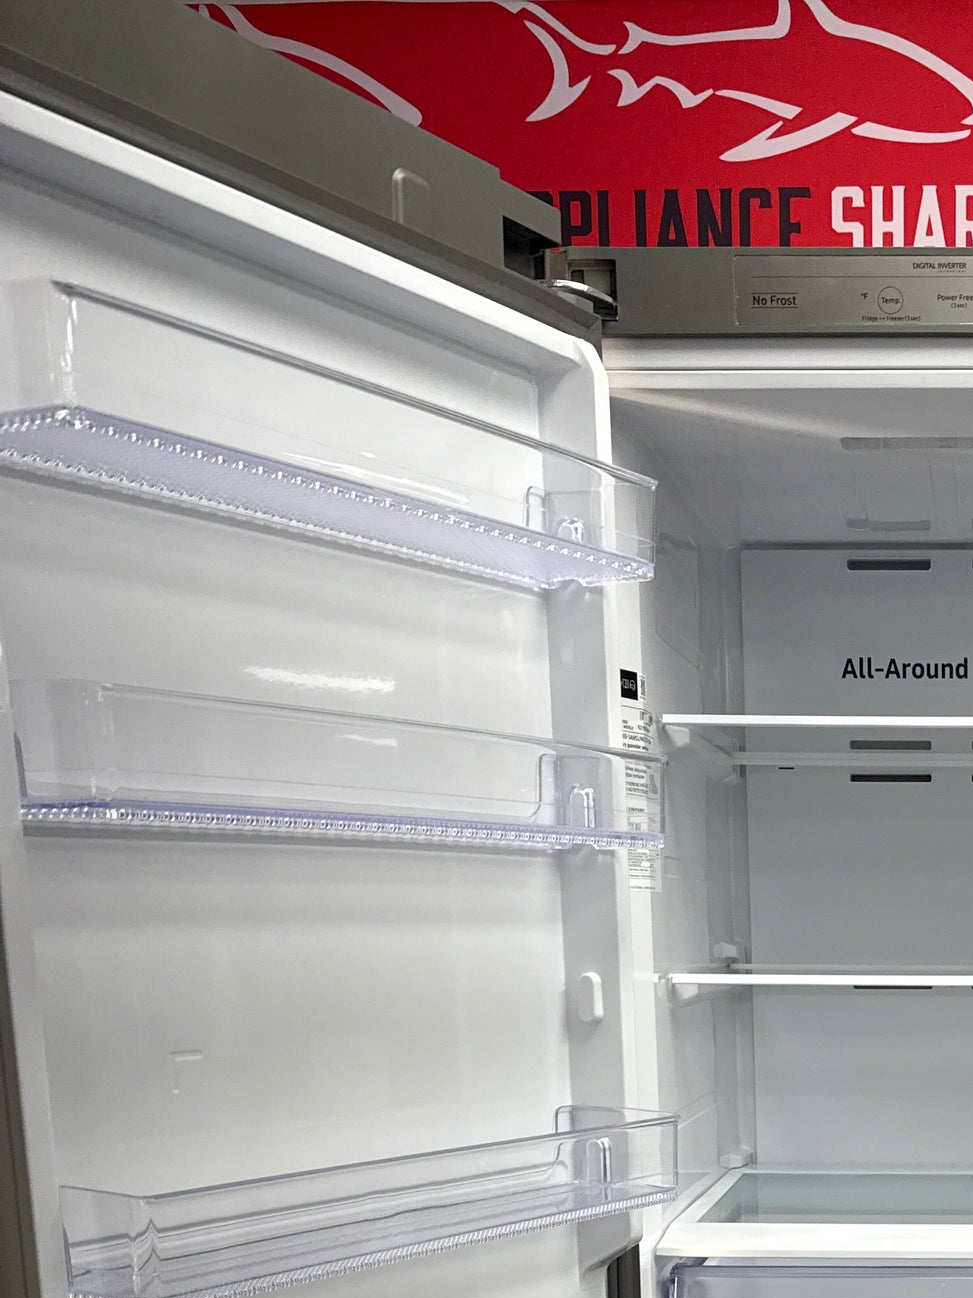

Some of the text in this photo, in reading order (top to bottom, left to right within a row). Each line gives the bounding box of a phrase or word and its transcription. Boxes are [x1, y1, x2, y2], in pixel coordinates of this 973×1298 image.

[752, 295, 797, 306] No Frost
[937, 293, 957, 301] Power
[841, 657, 968, 679] All-Around
